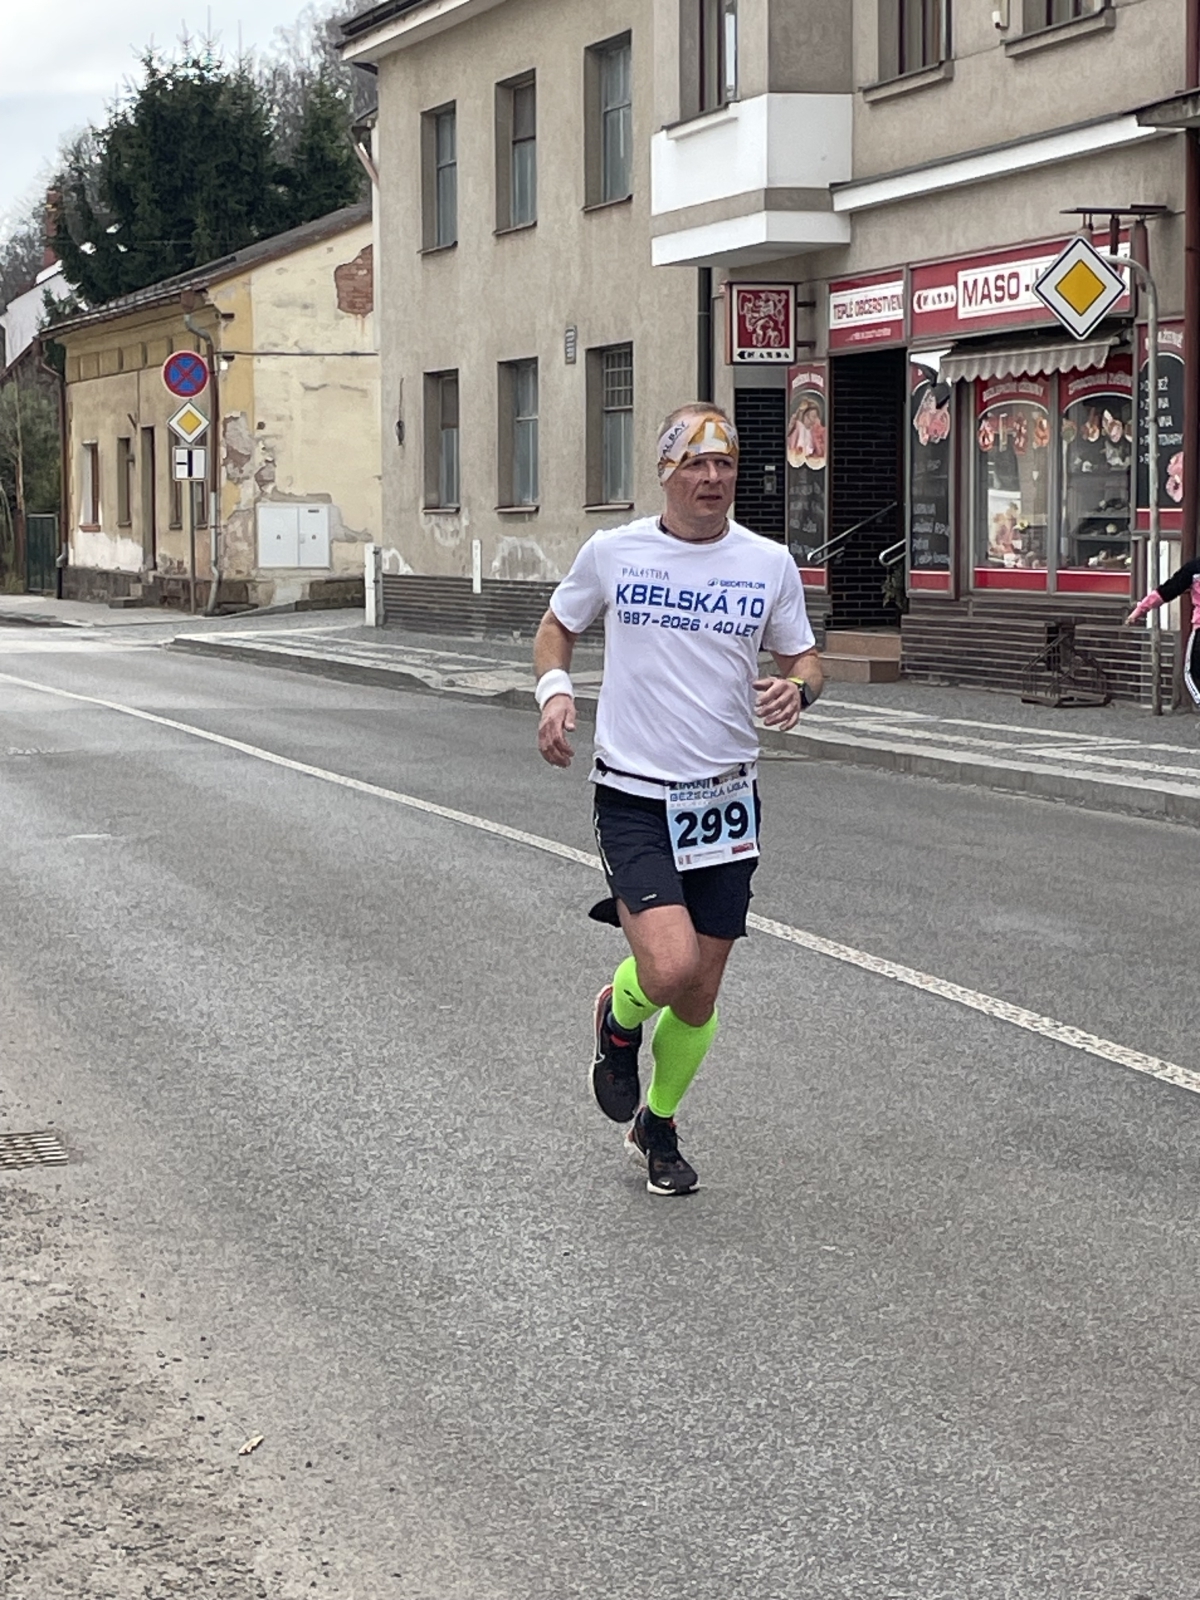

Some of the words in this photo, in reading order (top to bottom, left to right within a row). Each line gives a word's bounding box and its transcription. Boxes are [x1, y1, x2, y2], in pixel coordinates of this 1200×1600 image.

[962, 271, 1020, 308] MASO
[616, 583, 729, 615] KBELSKÁ
[736, 595, 765, 619] 10
[719, 579, 766, 590] DECATHLON
[617, 609, 701, 632] 1987-2026
[713, 620, 734, 635] 40
[736, 624, 760, 638] LET
[674, 801, 749, 850] 299
